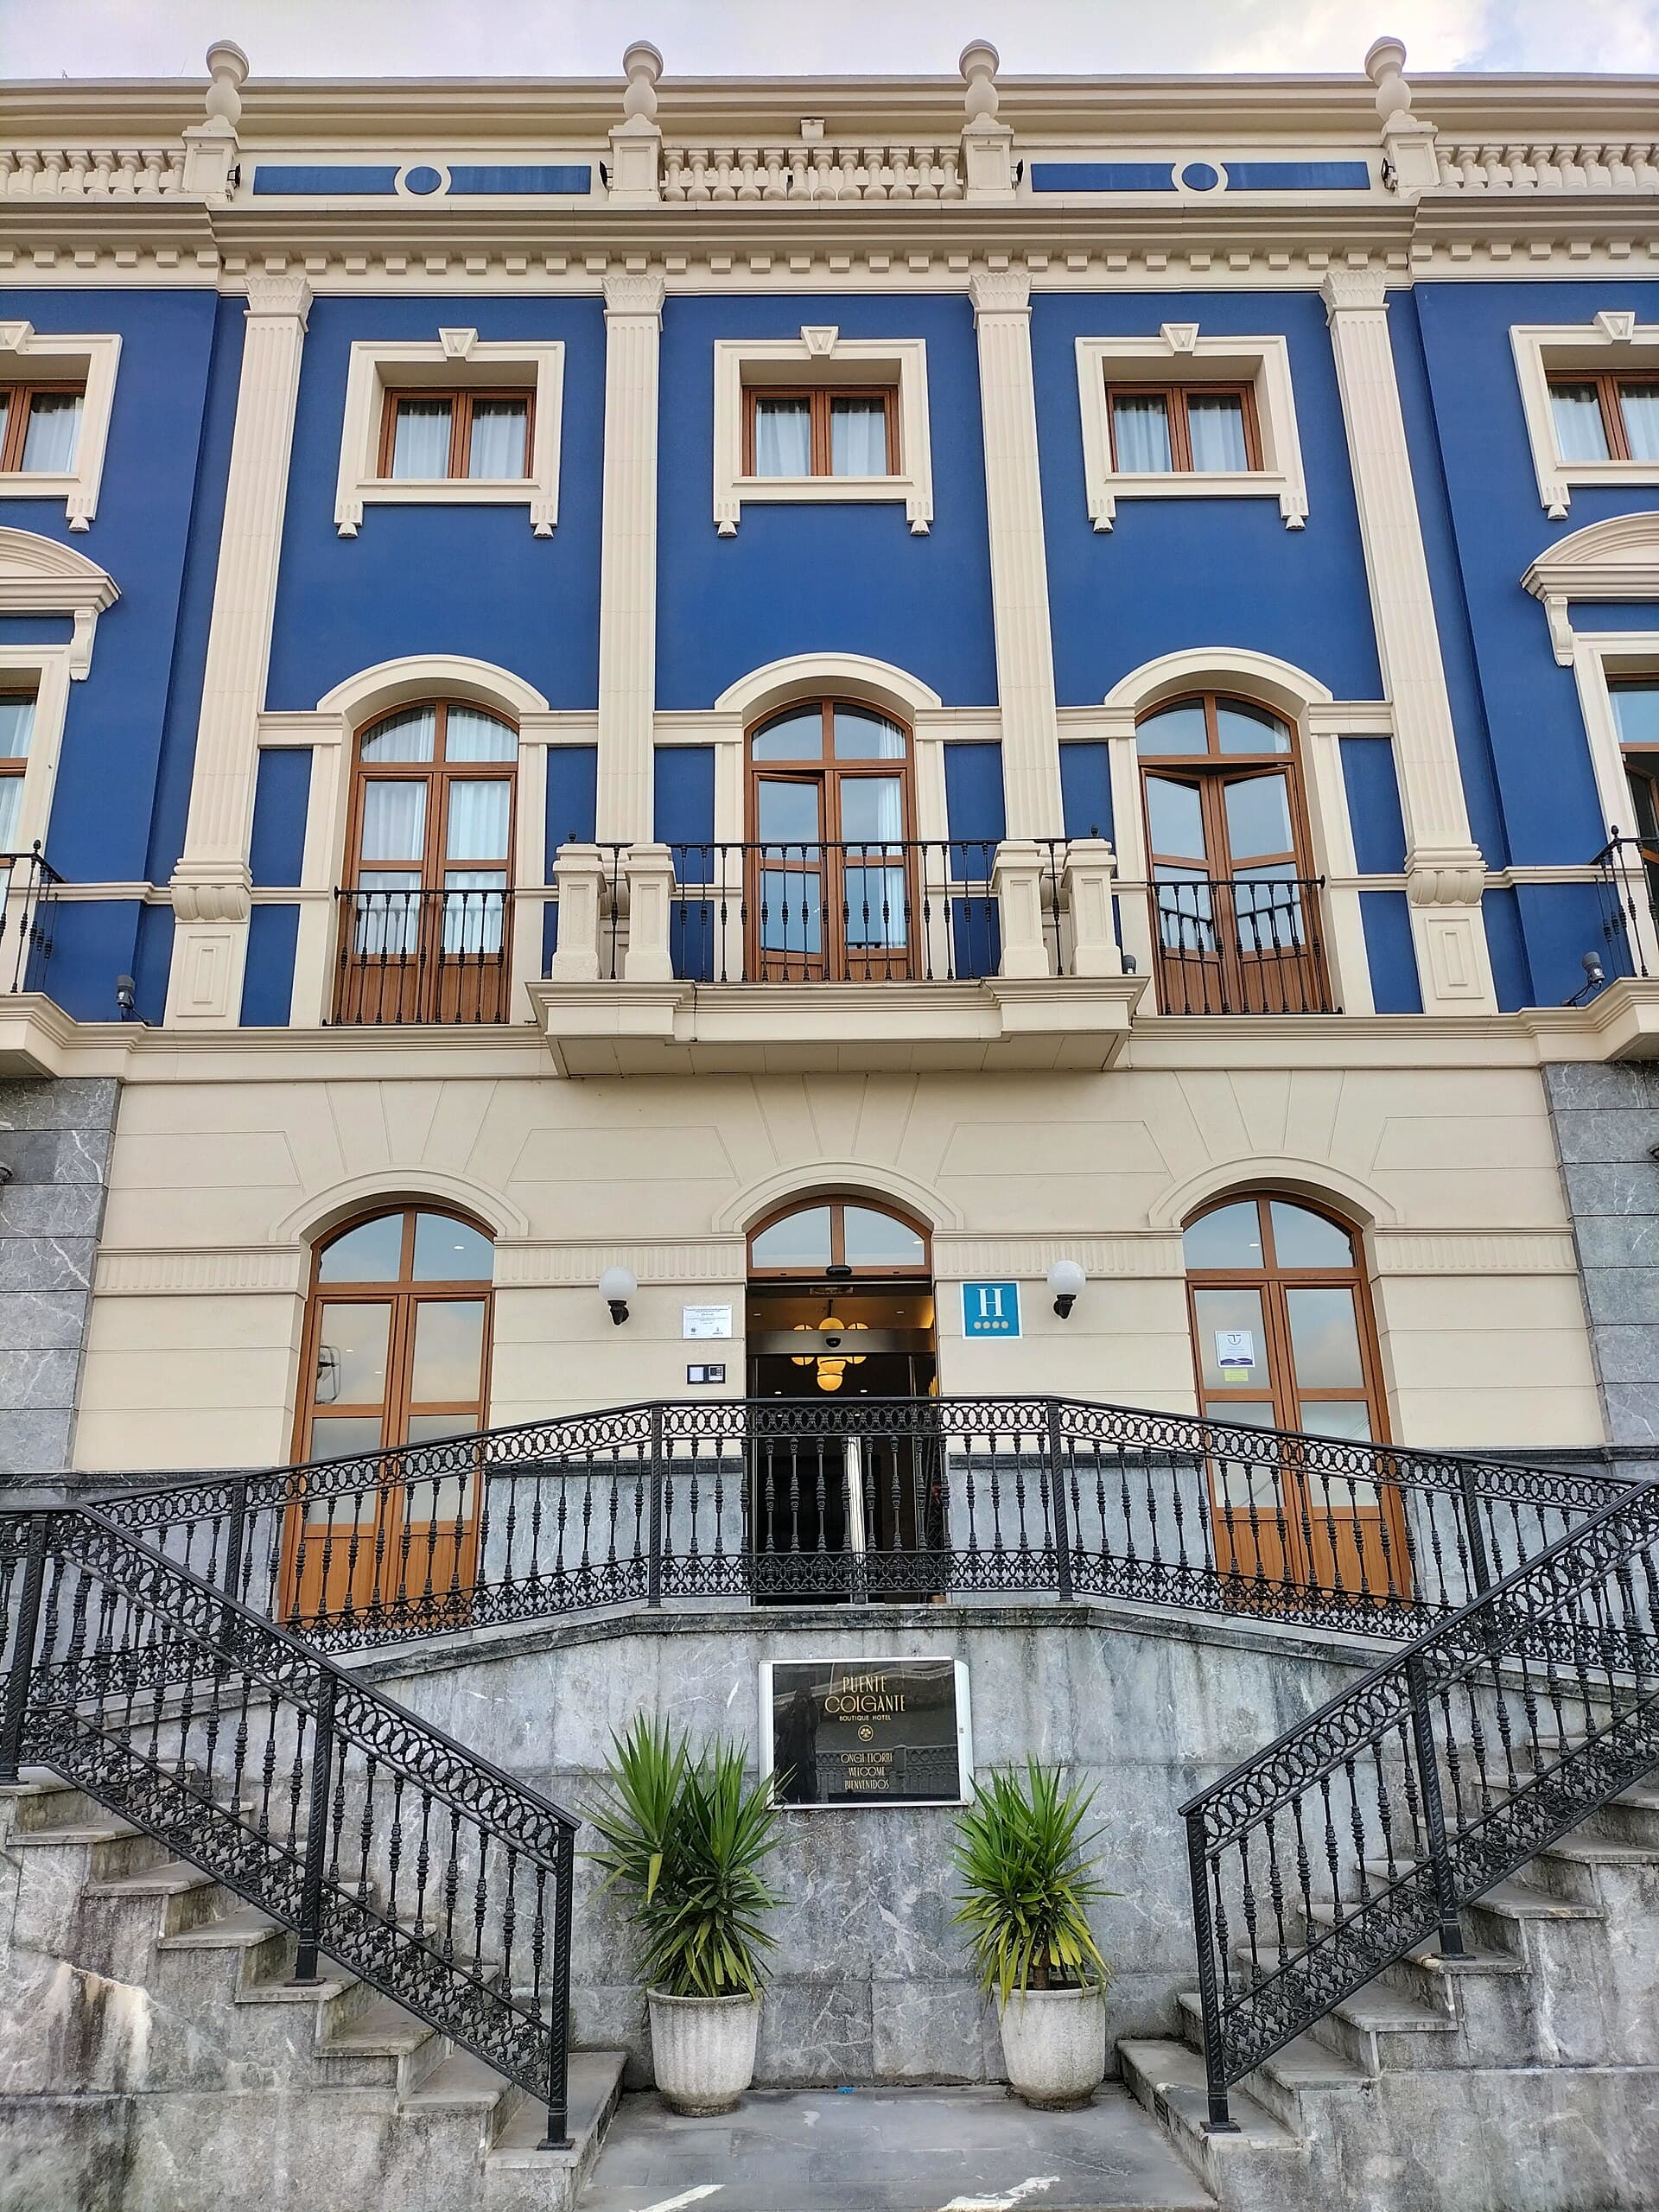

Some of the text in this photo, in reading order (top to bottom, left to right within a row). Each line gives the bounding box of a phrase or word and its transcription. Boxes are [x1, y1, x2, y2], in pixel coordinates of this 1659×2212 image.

[976, 1287, 1005, 1317] H
[842, 1675, 887, 1694] PUENTE
[824, 1694, 906, 1713] COLGANTE
[848, 1766, 886, 1777] WELCOME
[844, 1779, 890, 1790] BIENVENIDOS
